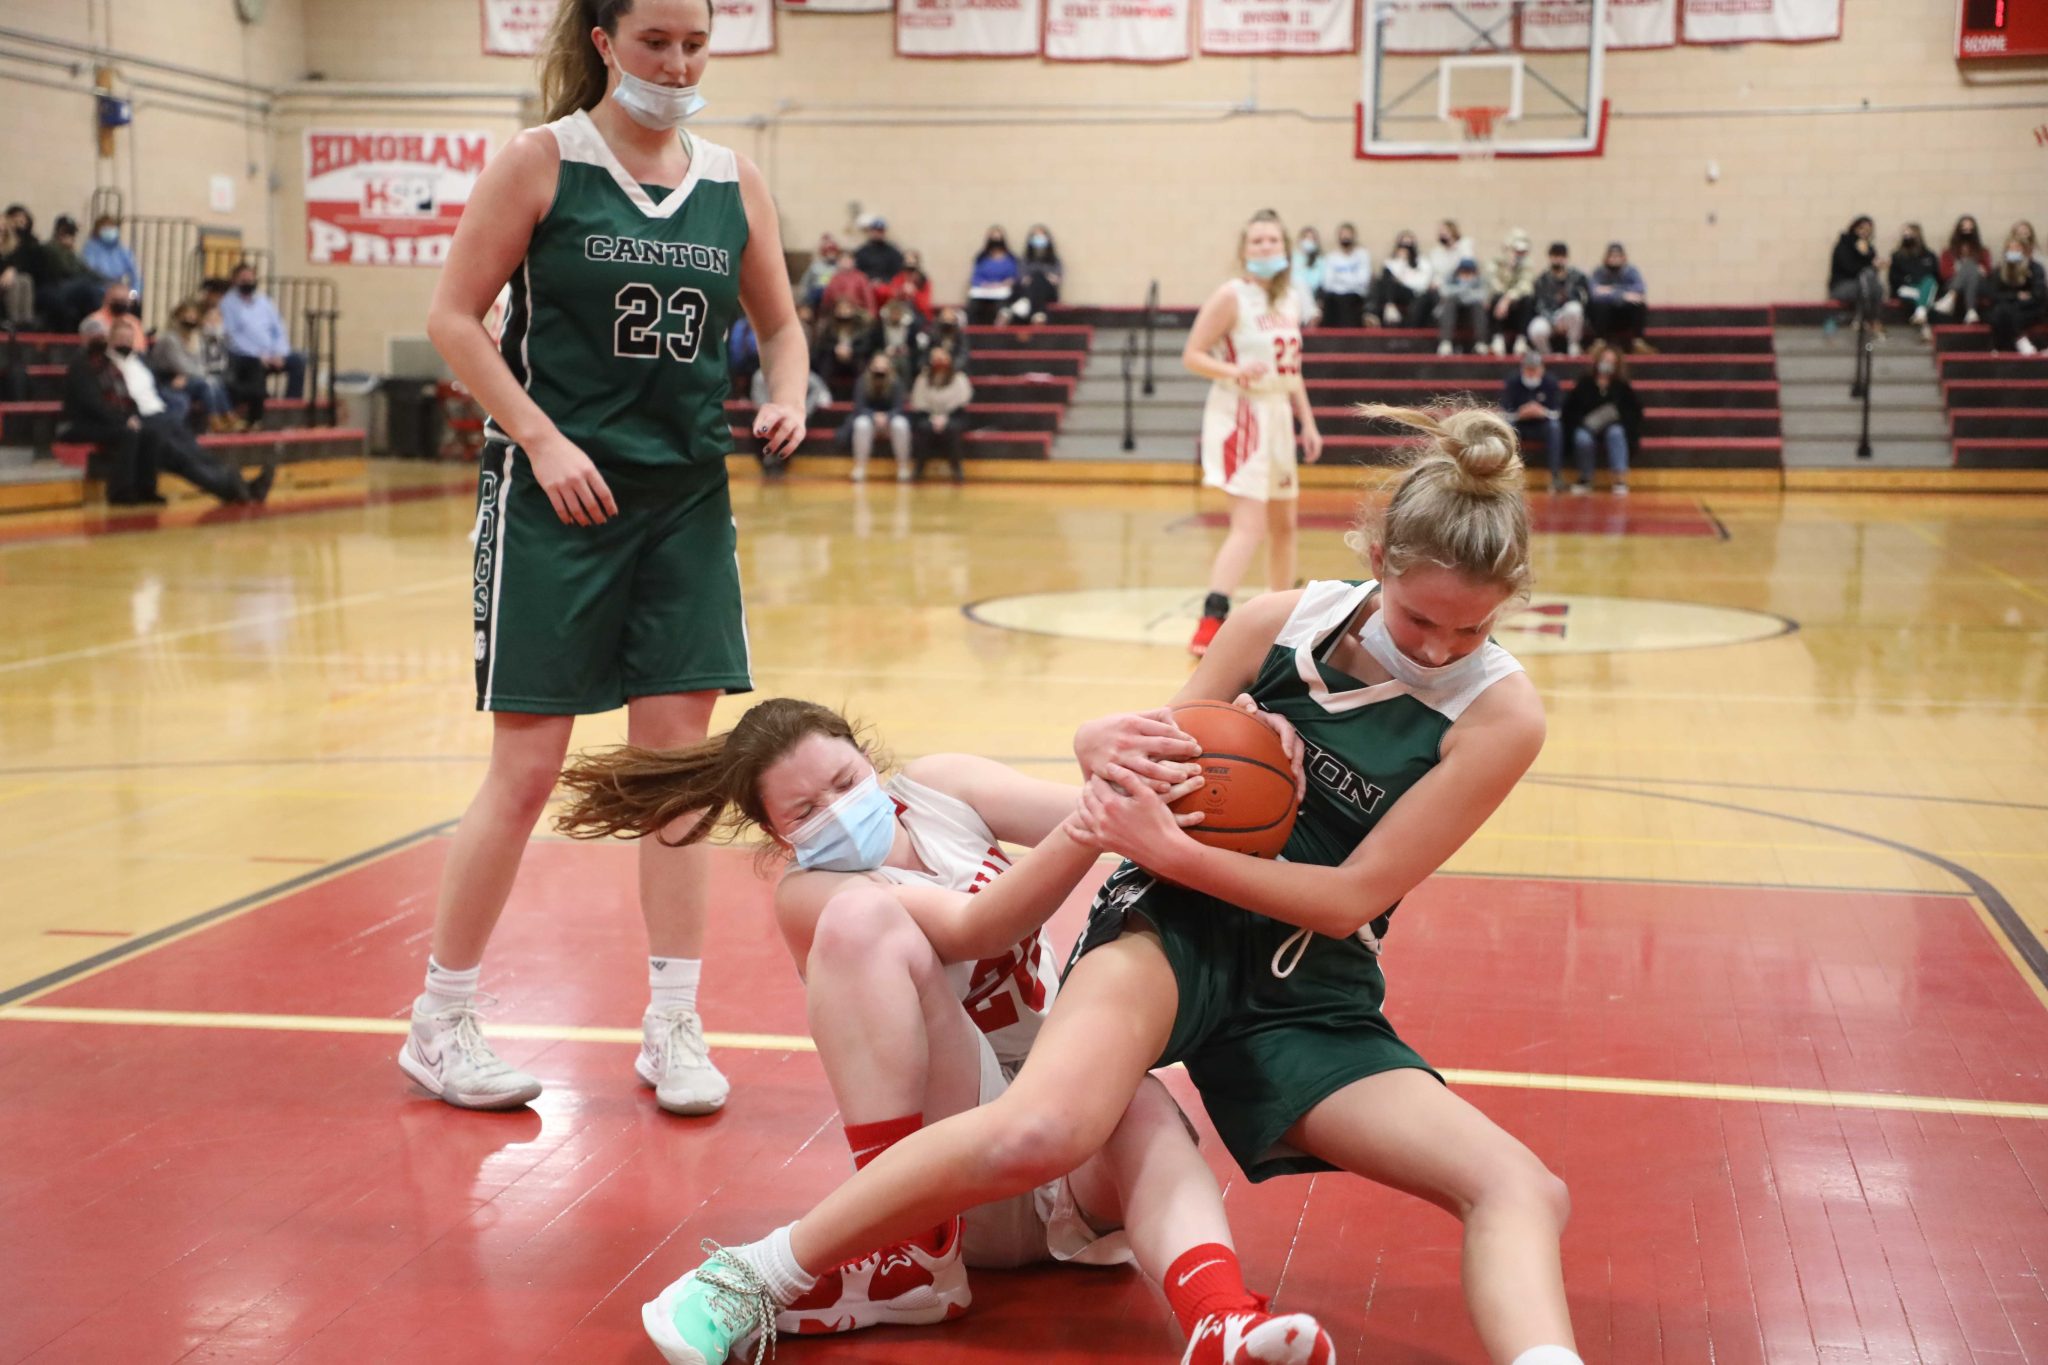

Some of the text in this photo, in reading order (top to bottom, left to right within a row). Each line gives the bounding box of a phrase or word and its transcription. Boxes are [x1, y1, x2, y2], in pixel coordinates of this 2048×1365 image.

[1963, 35, 2007, 52] SCORE
[309, 135, 486, 178] HINGHAM
[309, 219, 452, 263] PRID
[585, 235, 730, 276] CANTON
[614, 283, 708, 363] 23
